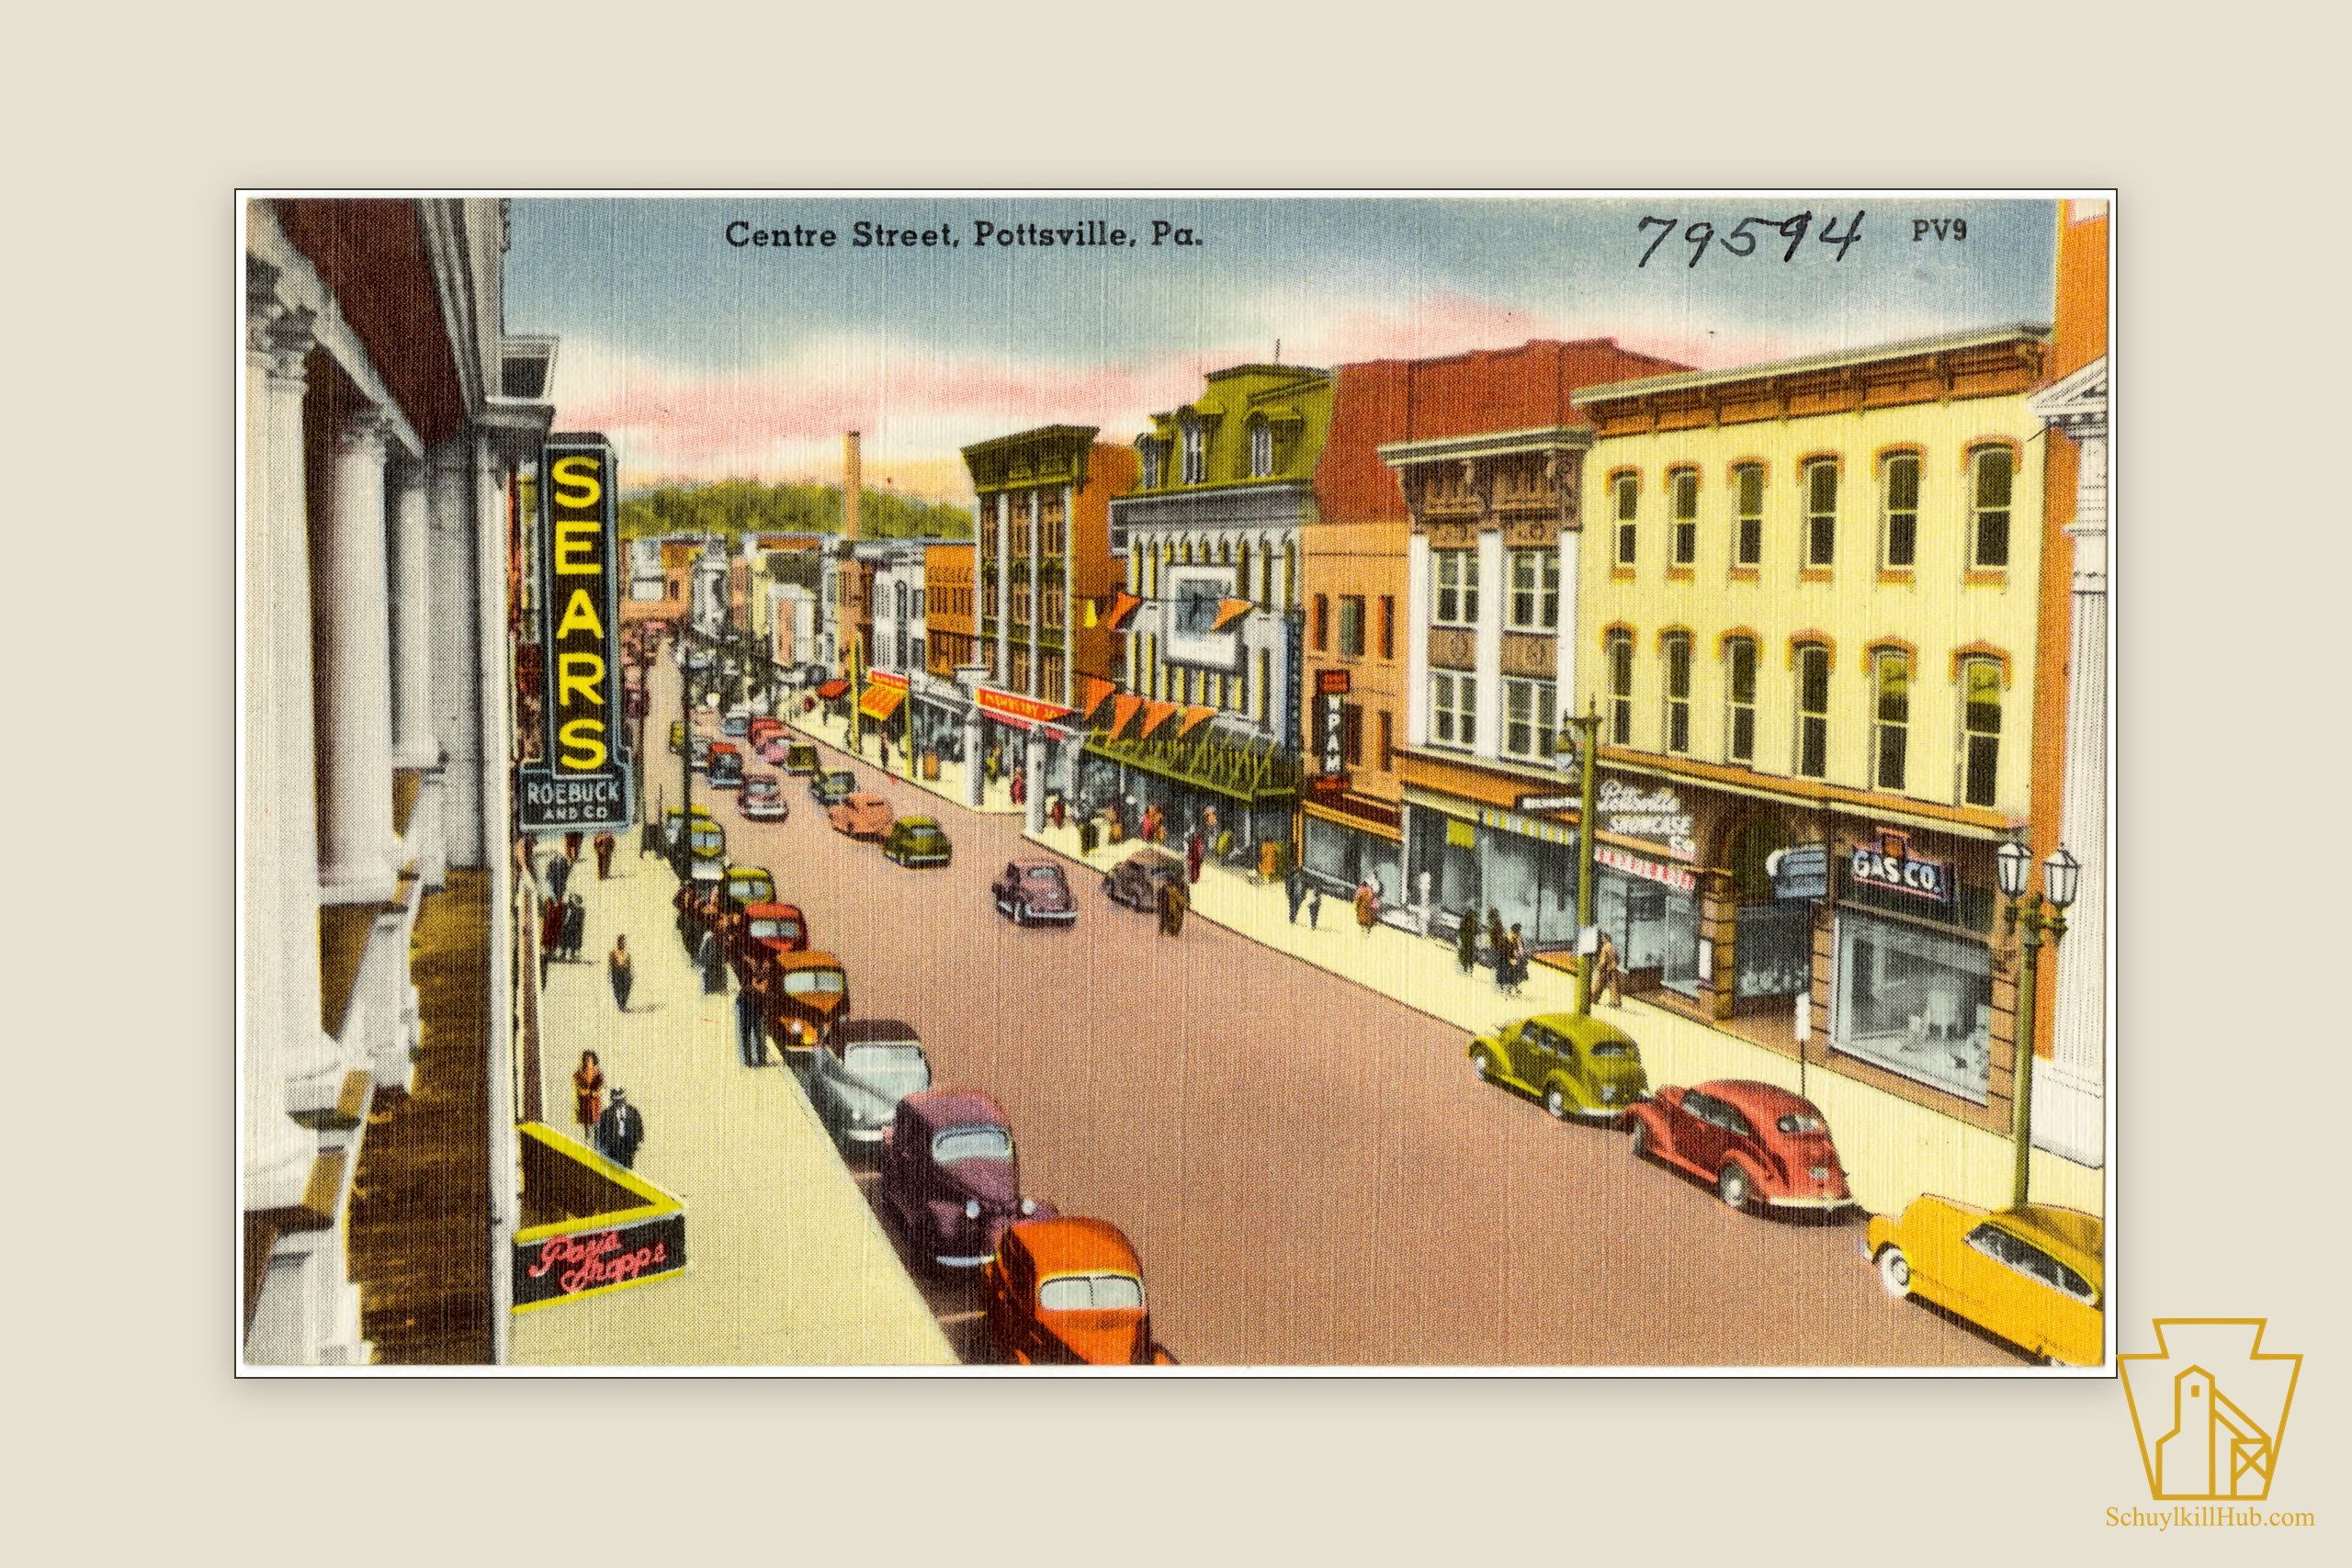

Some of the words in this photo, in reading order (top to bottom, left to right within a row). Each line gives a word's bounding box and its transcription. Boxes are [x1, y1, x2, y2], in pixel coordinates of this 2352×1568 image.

[725, 220, 837, 247] Centre
[852, 220, 959, 248] Street,
[974, 220, 1136, 248] Pottsville,
[1151, 220, 1203, 247] Pa.
[1638, 210, 1865, 268] 79594
[1913, 219, 1967, 242] PV9
[552, 457, 606, 770] SEARS
[527, 781, 620, 805] ROEBUCK
[543, 806, 579, 820] AND
[1610, 815, 1693, 835] SHOWCASE
[1852, 849, 1902, 884] GAS
[1903, 861, 1942, 894] CO.
